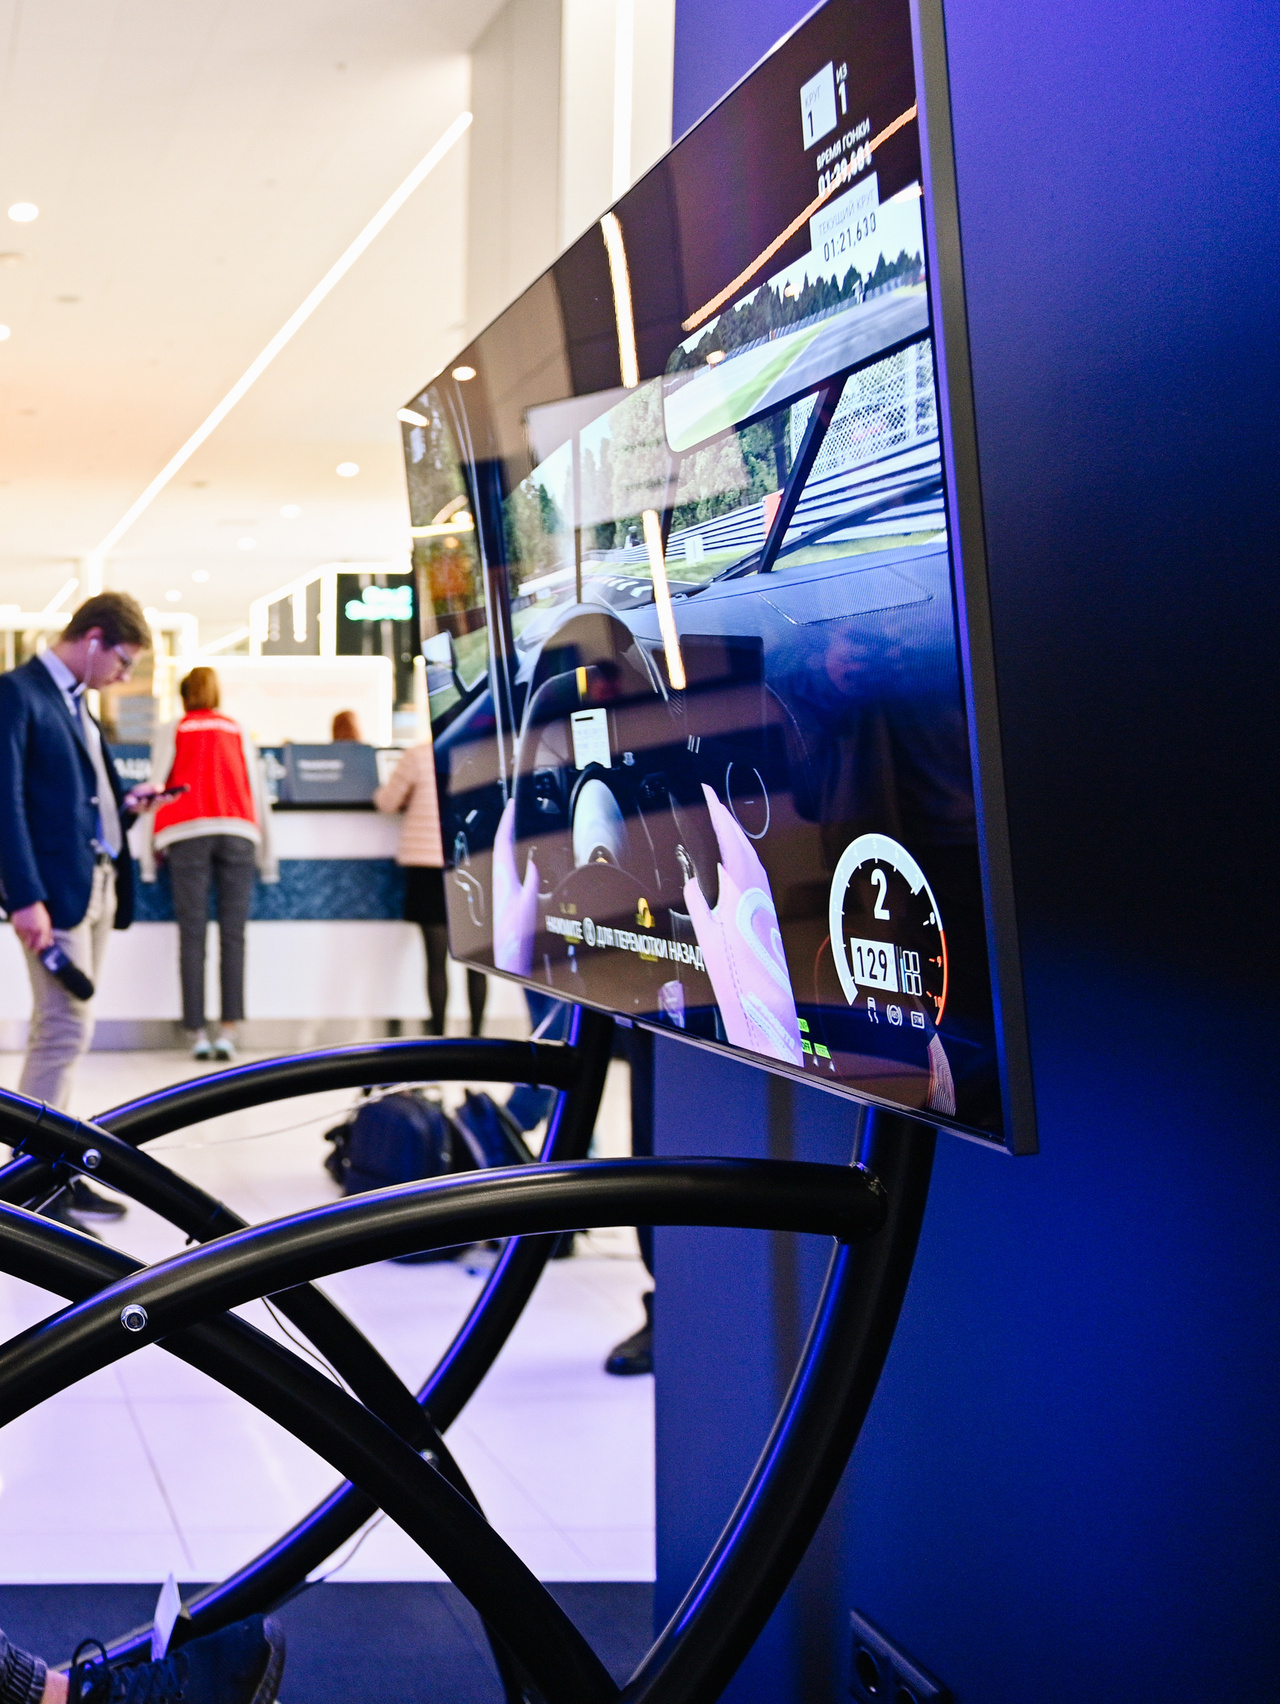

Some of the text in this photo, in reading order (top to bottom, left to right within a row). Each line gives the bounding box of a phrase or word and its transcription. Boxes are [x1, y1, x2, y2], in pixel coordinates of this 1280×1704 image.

[816, 116, 870, 172] ВРЕМЯ ГОНКИ
[870, 867, 891, 921] 2
[667, 940, 706, 973] НАЗАД
[856, 945, 888, 982] 129
